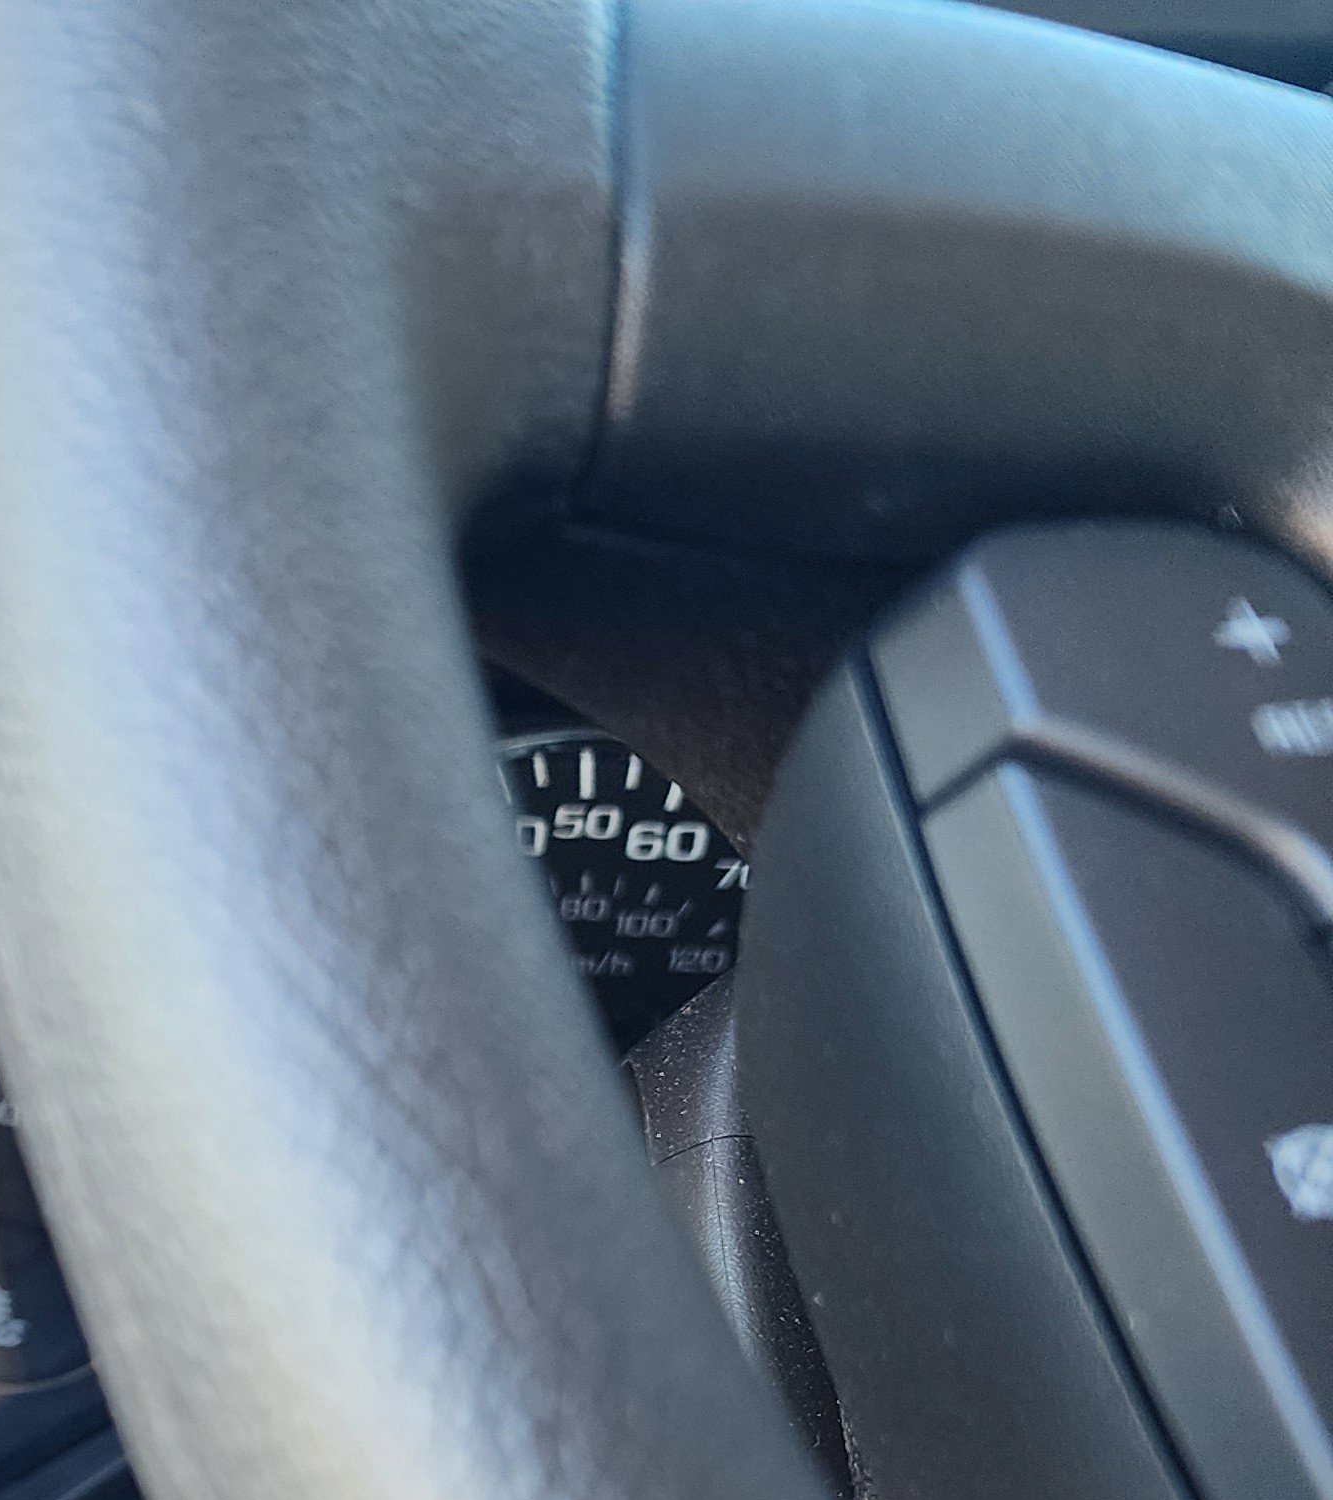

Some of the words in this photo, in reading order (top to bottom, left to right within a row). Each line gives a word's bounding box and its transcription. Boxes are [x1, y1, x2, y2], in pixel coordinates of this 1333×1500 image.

[514, 815, 550, 858] 0
[553, 804, 623, 840] 50
[625, 821, 709, 861] 60
[615, 910, 679, 937] 100
[668, 946, 730, 973] 120
